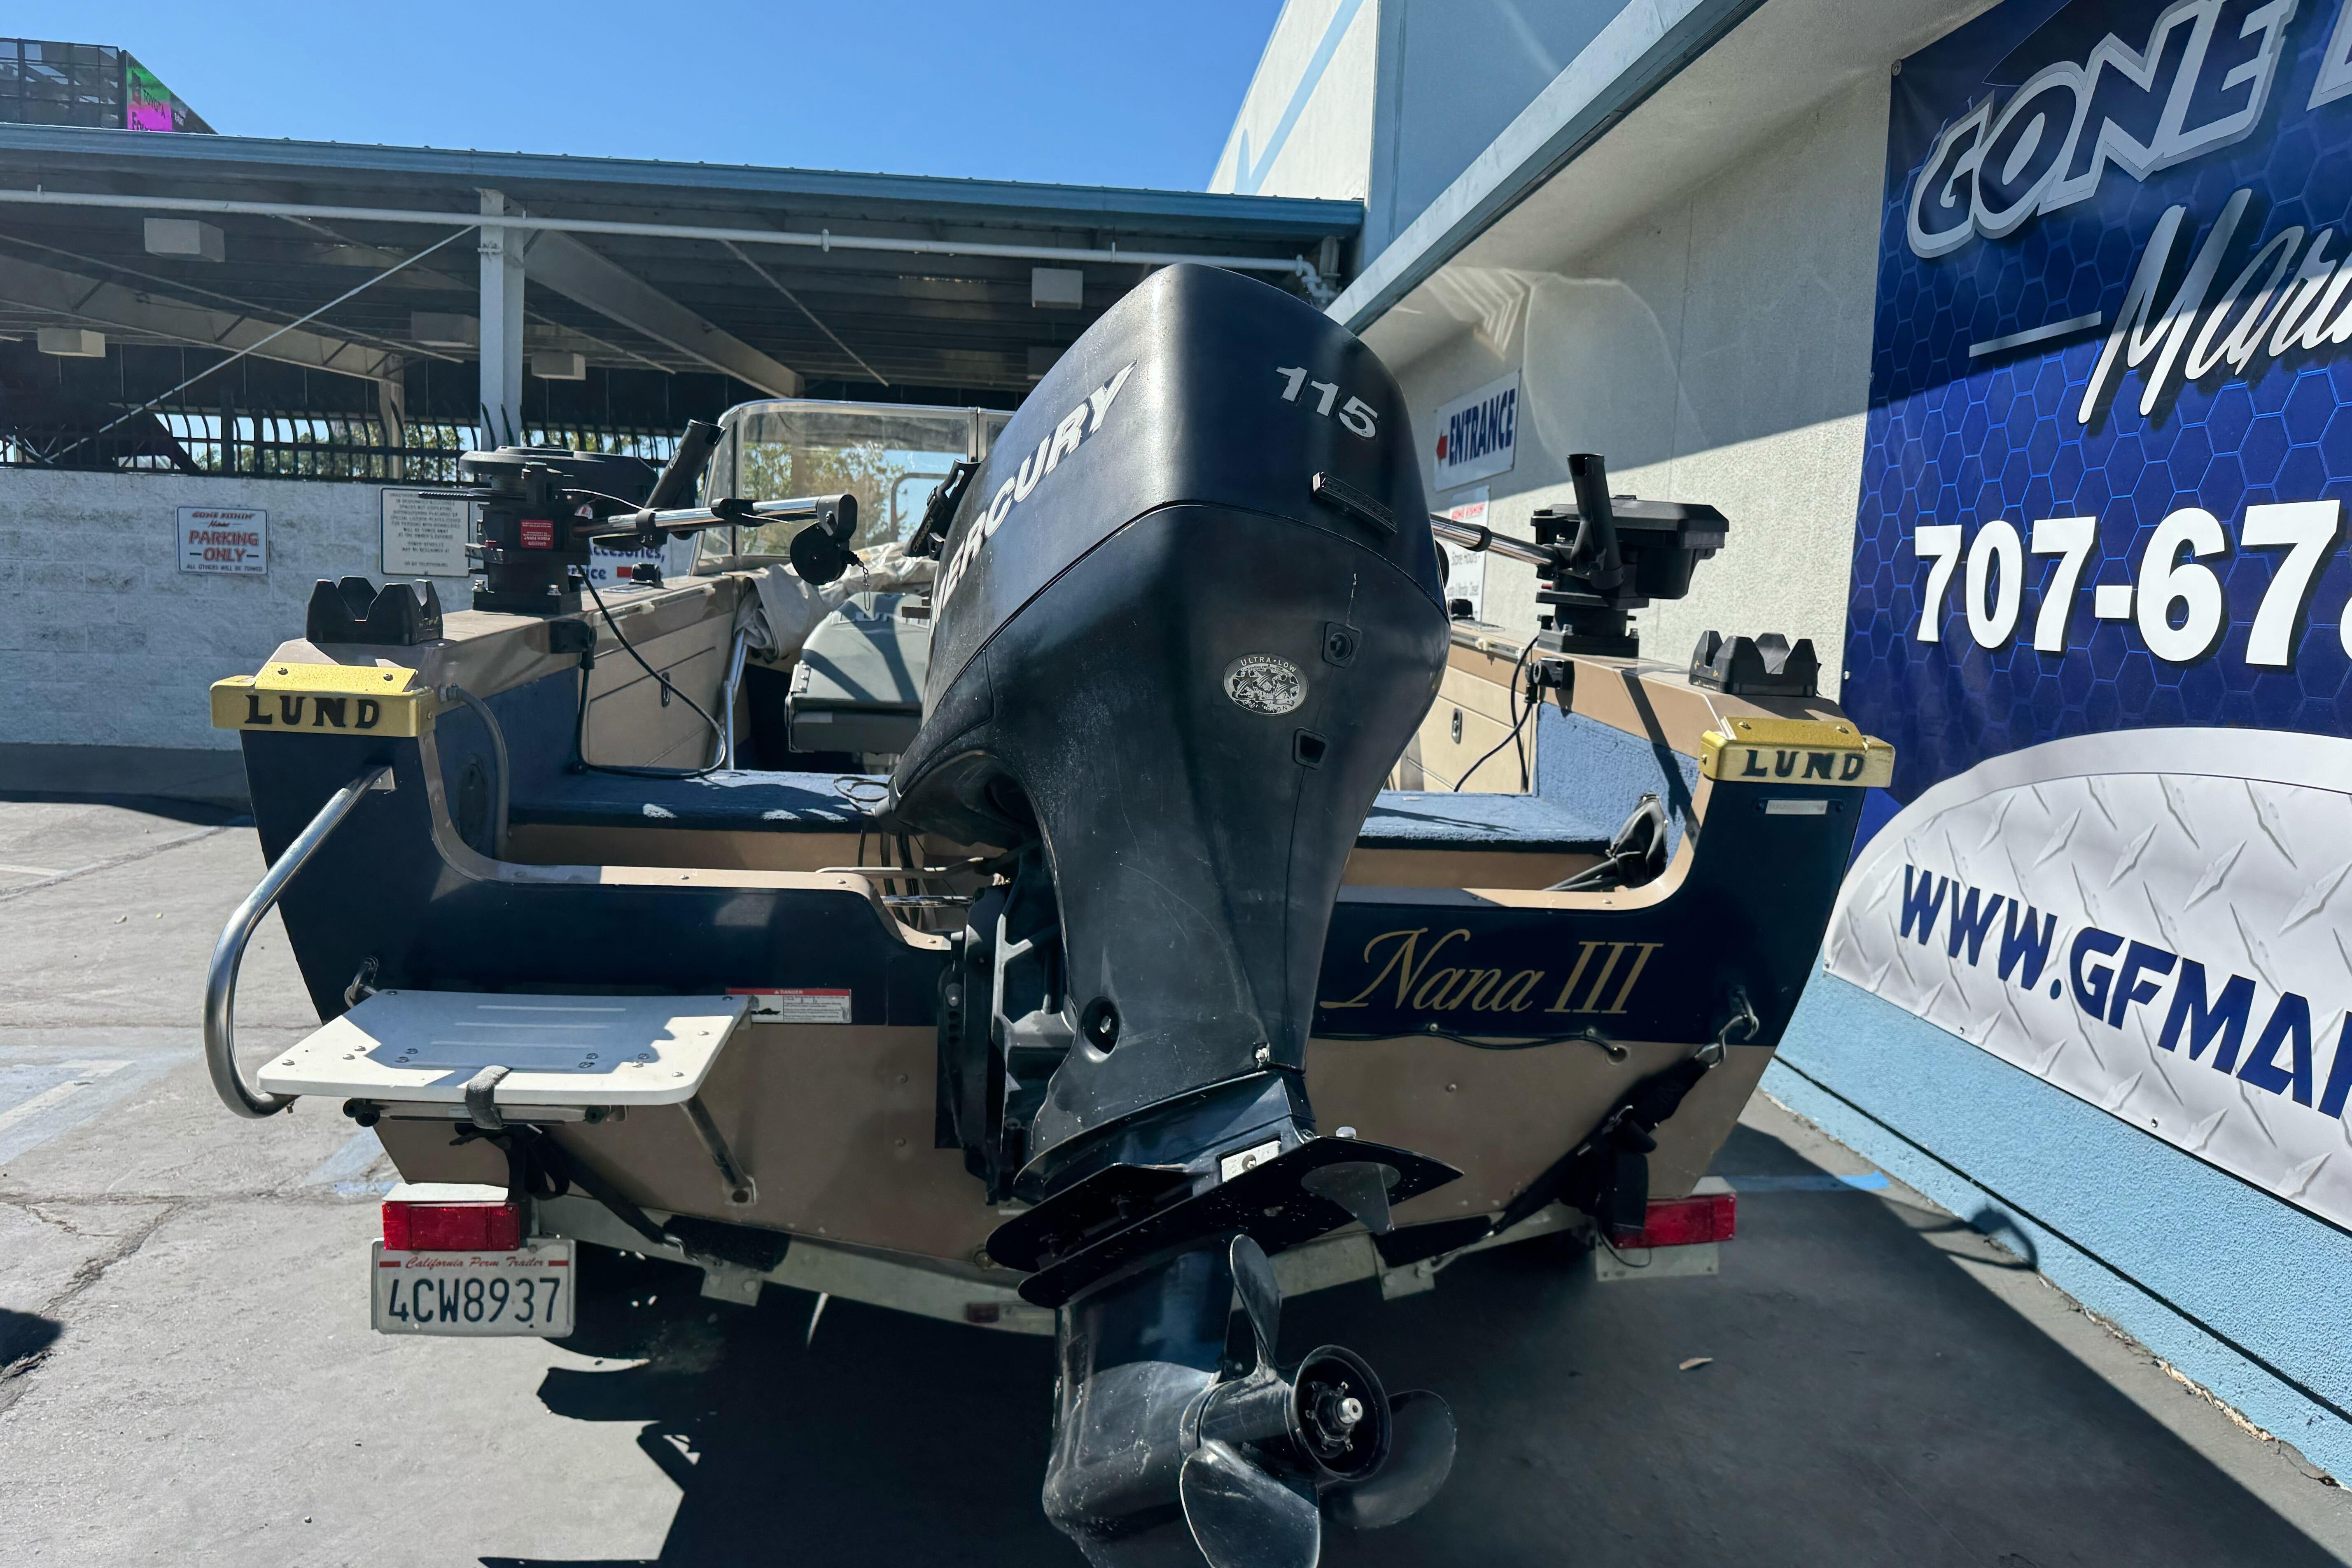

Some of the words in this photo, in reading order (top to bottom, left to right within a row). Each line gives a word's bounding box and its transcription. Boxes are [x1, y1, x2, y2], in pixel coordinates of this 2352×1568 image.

[143, 89, 166, 119] TOYOTA
[1908, 0, 2298, 259] GONE
[2078, 188, 2352, 424] Mari
[1276, 366, 1378, 438] 115
[1449, 388, 1515, 467] ENTRANCE
[189, 530, 259, 547] PARKING
[203, 547, 246, 562] ONLY
[1915, 499, 2352, 666] 707-67
[244, 695, 381, 729] LUND
[1741, 749, 1866, 782] LUND
[1319, 927, 1545, 1012] Nana
[1544, 941, 1664, 1015] III
[405, 1256, 463, 1270] California
[469, 1256, 499, 1267] Perm
[506, 1256, 544, 1267] Trailer
[389, 1277, 560, 1323] 4CW8937
